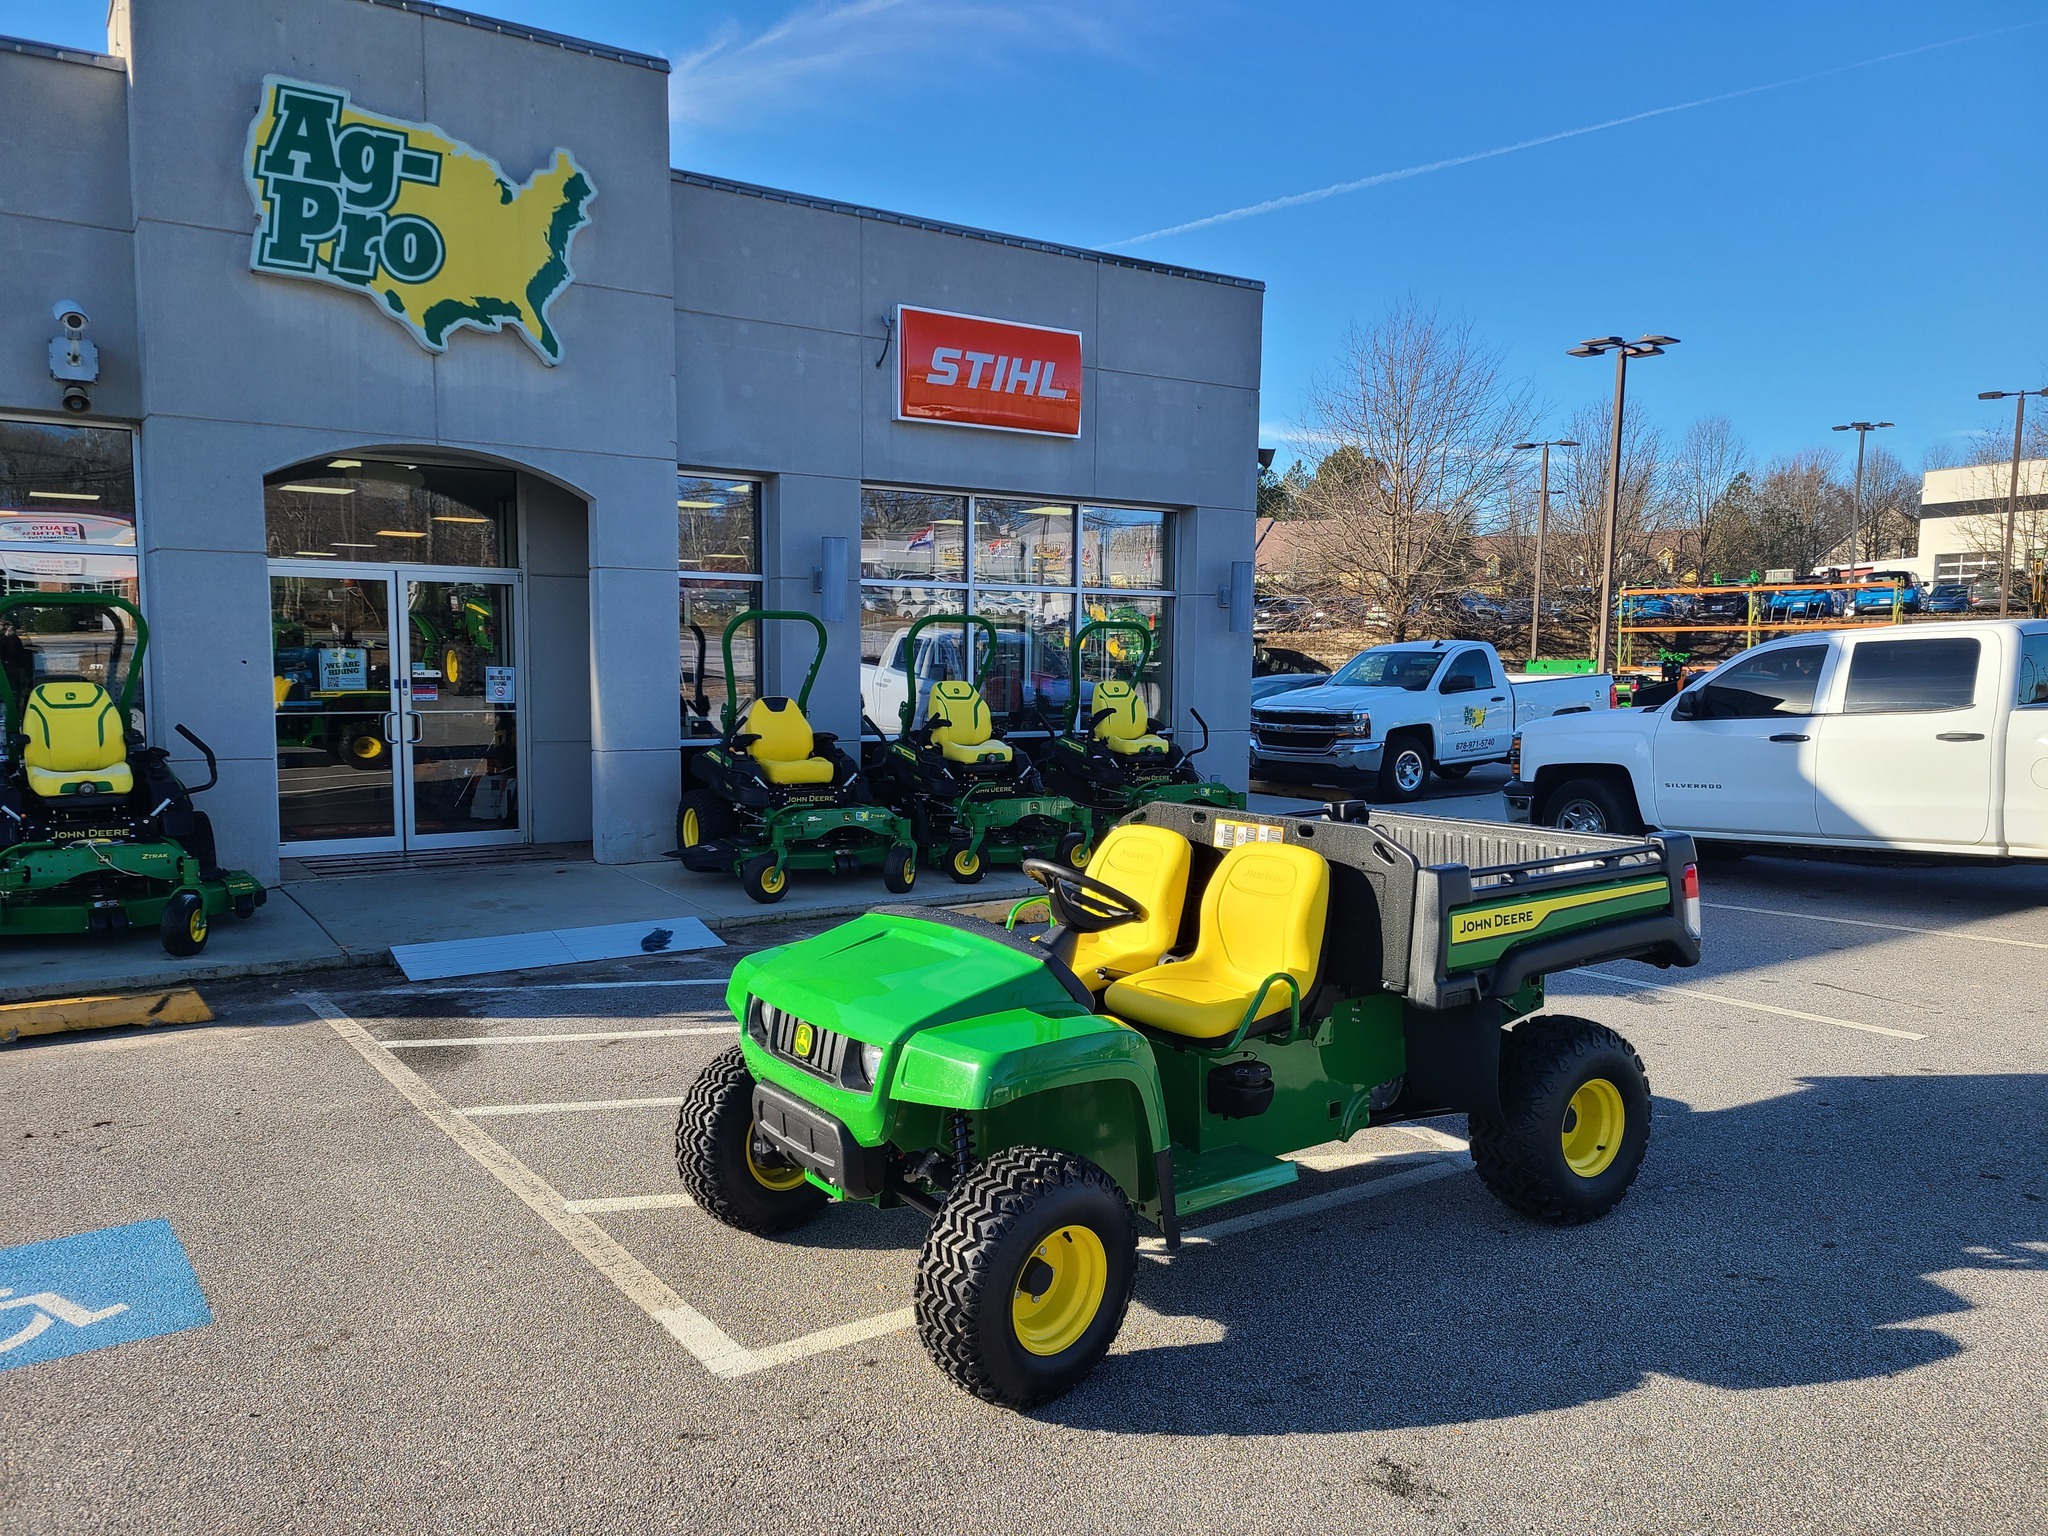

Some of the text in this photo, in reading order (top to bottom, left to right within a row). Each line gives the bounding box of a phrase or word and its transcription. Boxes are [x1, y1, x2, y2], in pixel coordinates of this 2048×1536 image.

[253, 84, 442, 211] Ag-
[257, 178, 446, 284] Pro
[926, 346, 1067, 399] STIHL
[327, 667, 360, 676] HIRING
[342, 660, 360, 668] ARE
[1455, 738, 1496, 751] 678-971-5740
[51, 828, 131, 840] JOHN DEERE
[1459, 911, 1534, 934] JOHN DEERE
